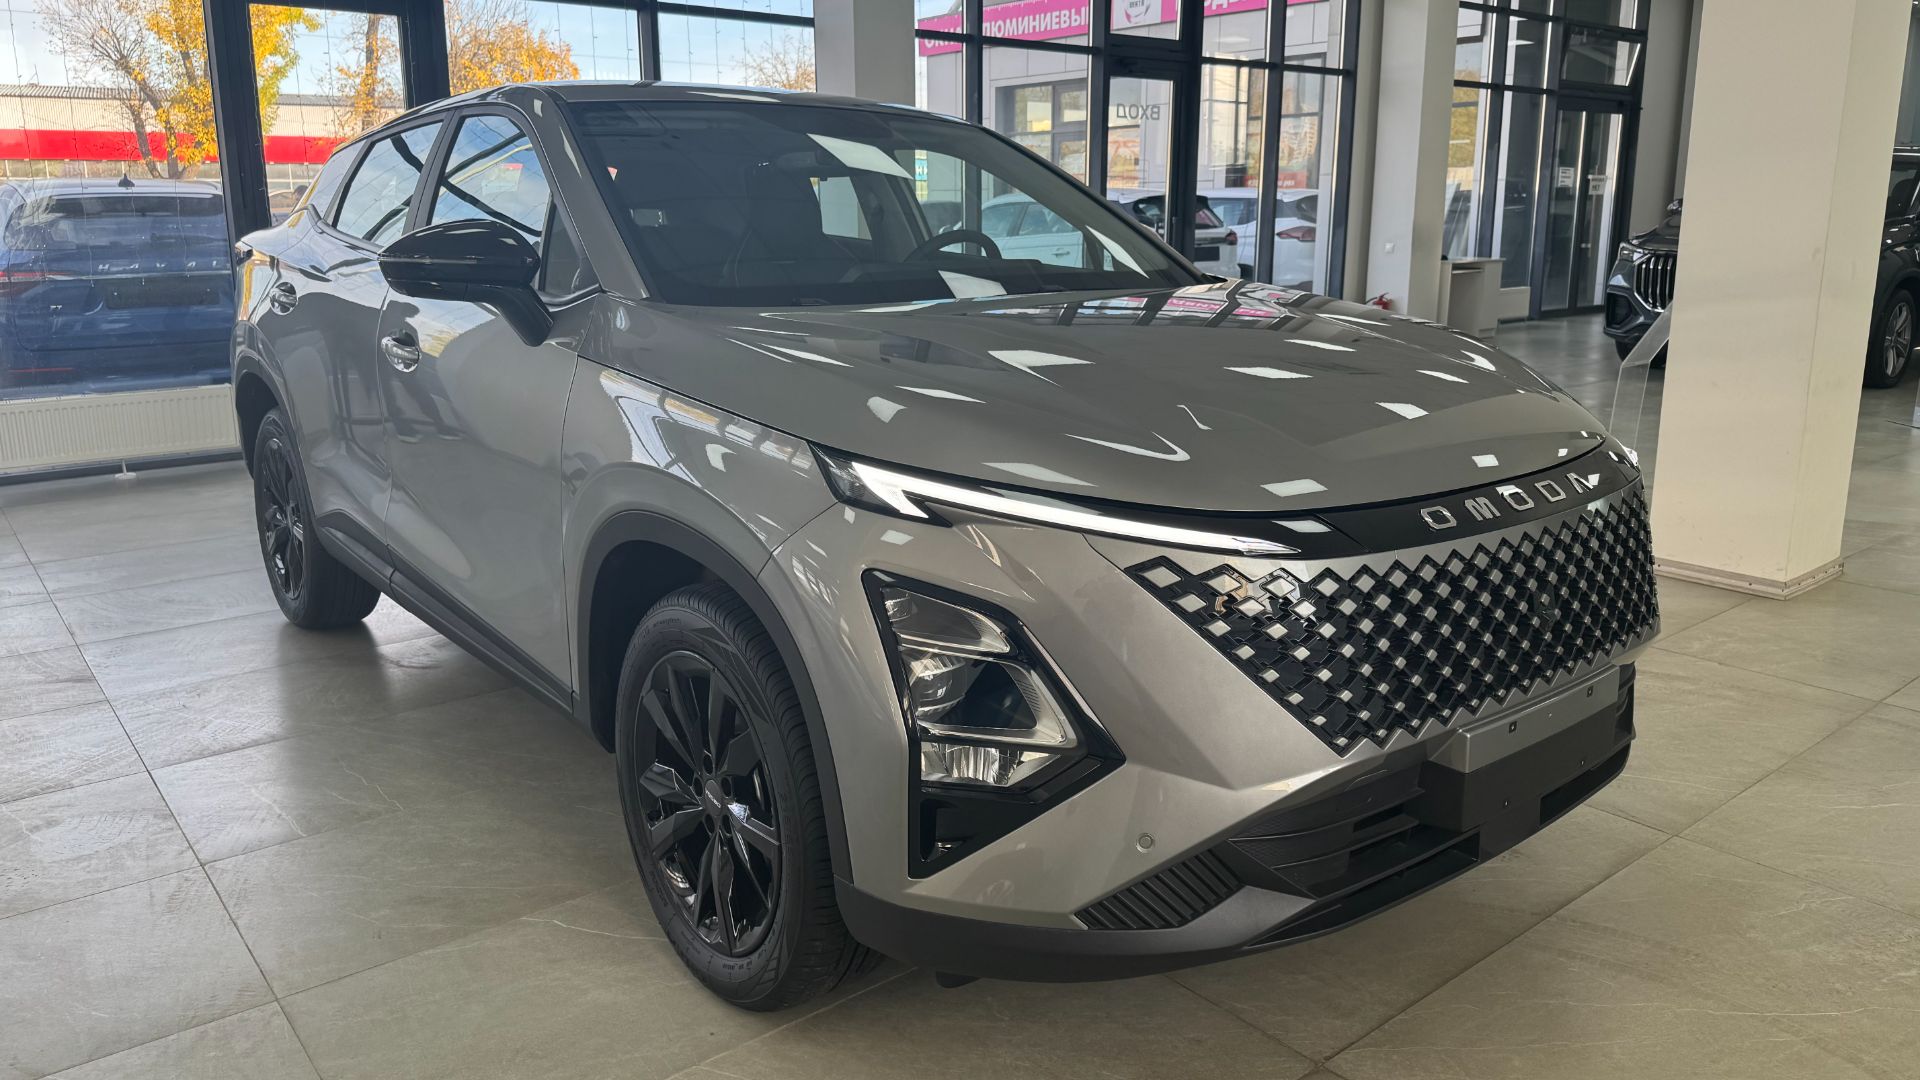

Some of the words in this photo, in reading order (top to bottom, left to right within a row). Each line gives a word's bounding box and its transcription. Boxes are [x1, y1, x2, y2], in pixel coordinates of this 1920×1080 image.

[983, 6, 1088, 37] ЛЮМИНИЕВЫ
[98, 260, 218, 270] HAVAL
[1420, 472, 1595, 530] OMODA
